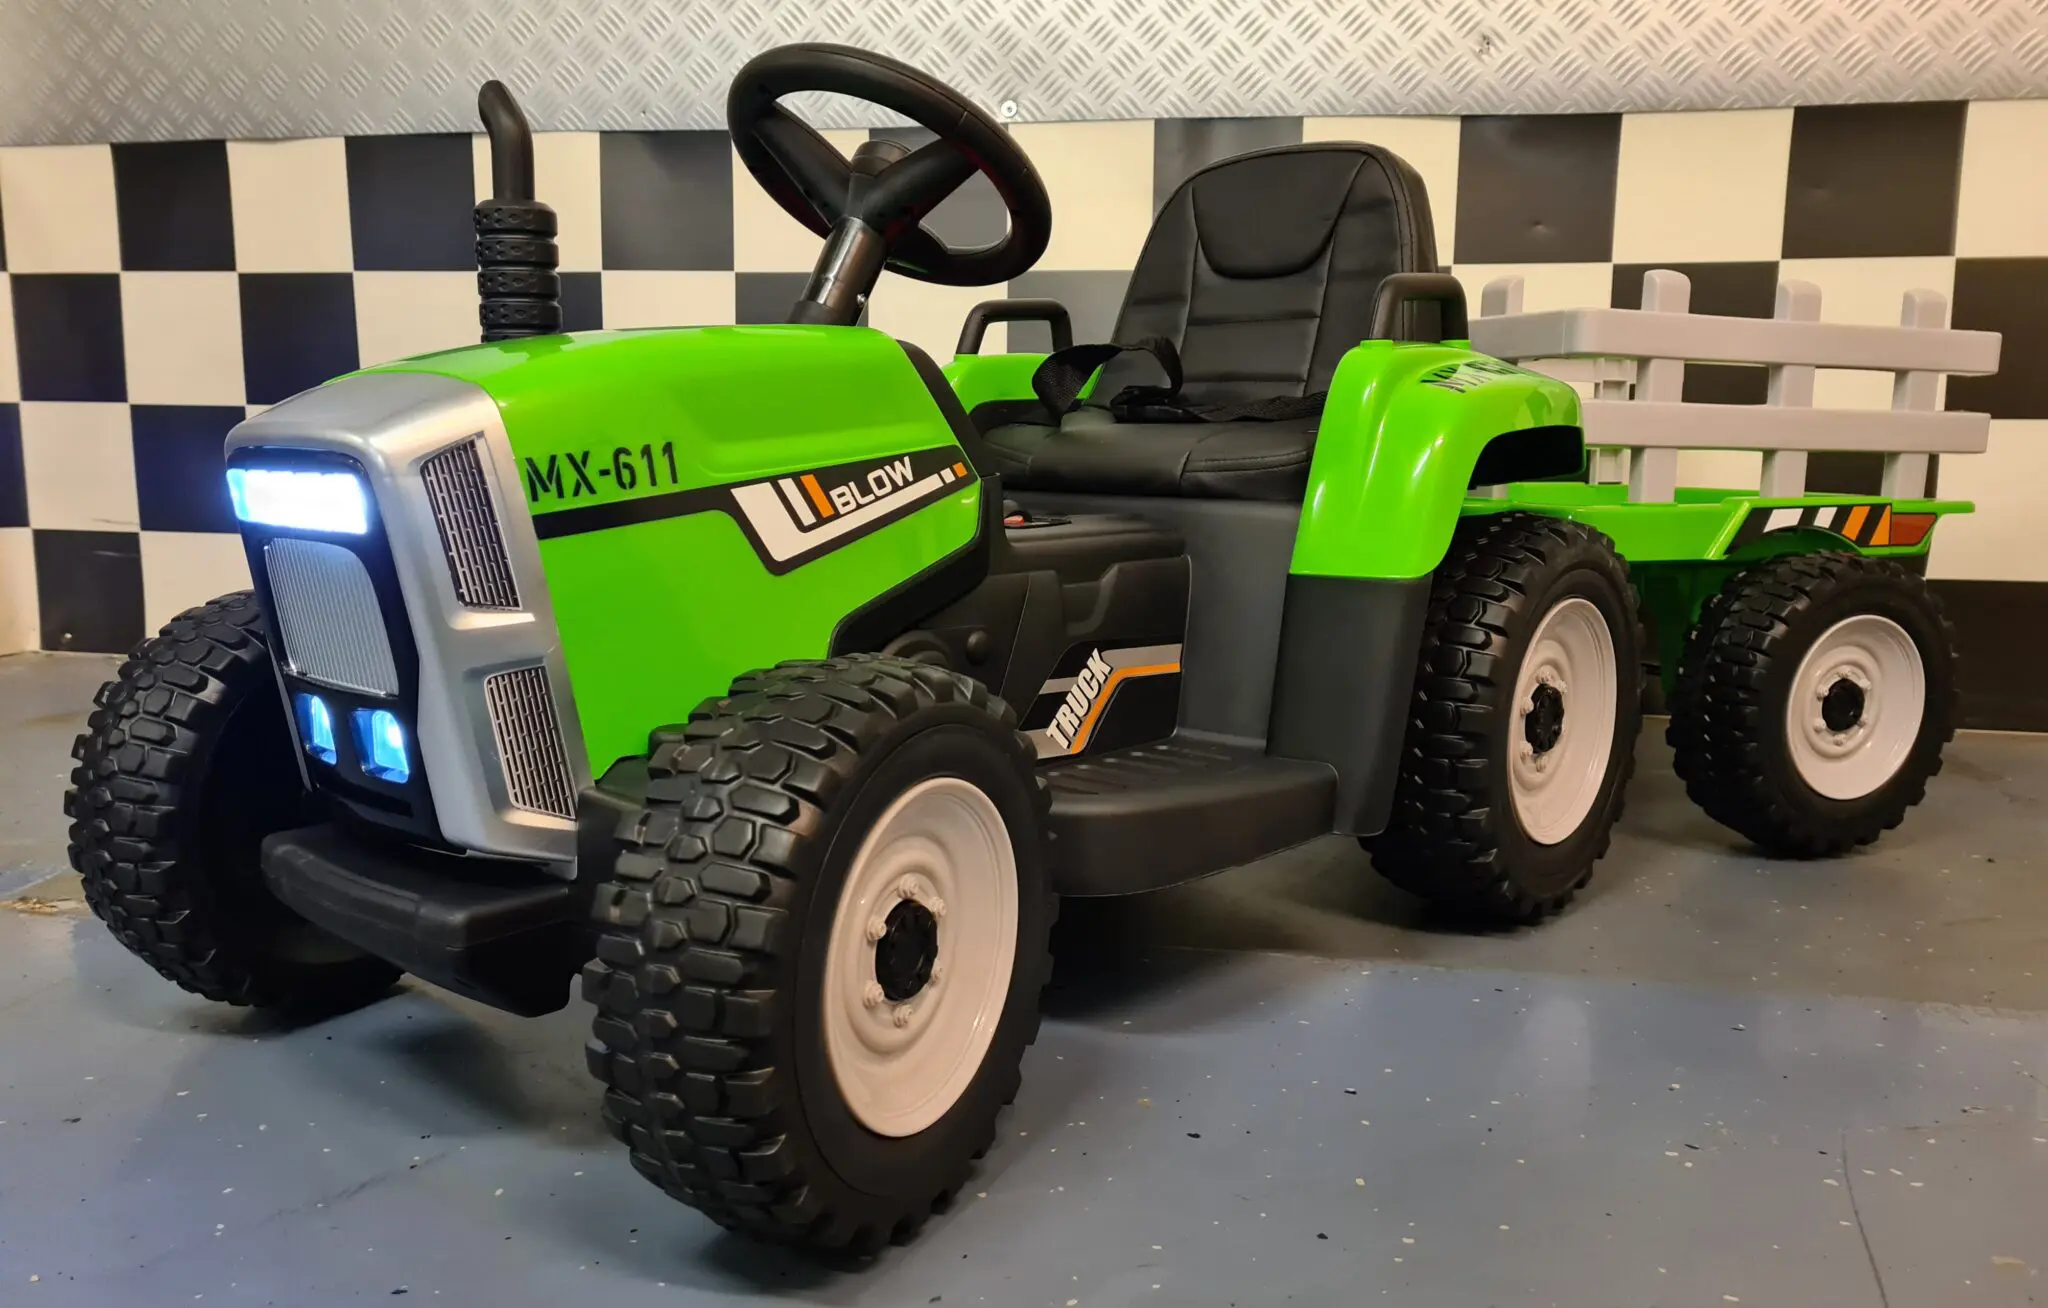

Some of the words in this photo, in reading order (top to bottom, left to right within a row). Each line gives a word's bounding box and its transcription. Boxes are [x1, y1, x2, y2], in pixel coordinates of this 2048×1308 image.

[524, 441, 679, 502] MX-611
[829, 456, 914, 516] BLOW
[1046, 648, 1112, 750] TRUCK
